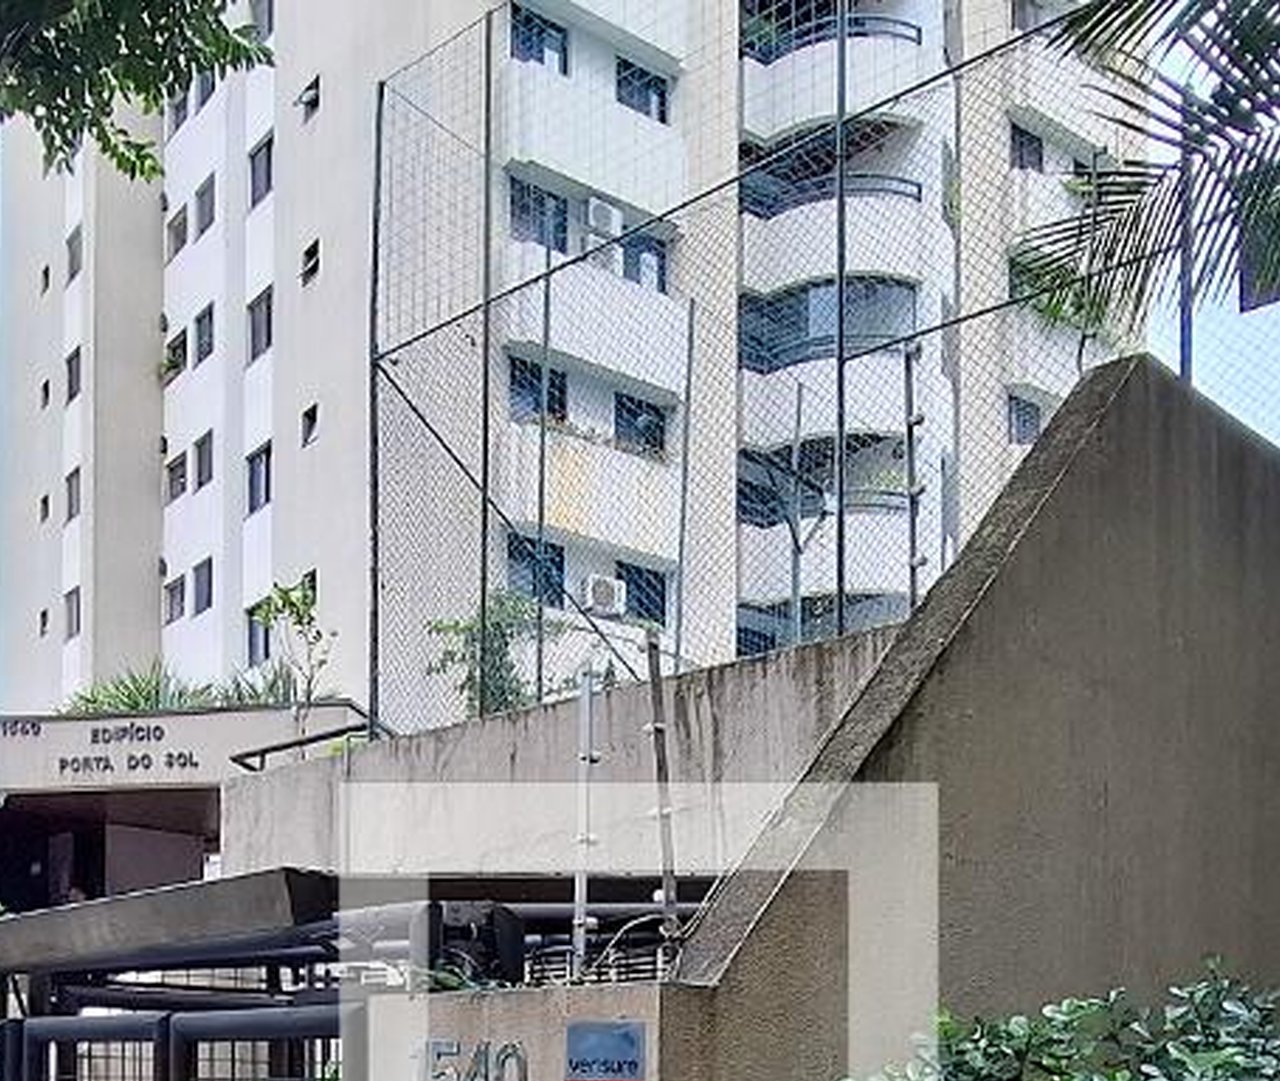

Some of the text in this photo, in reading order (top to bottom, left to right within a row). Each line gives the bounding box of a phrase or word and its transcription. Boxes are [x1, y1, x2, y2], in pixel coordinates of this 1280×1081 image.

[58, 751, 199, 774] PORTA DO SOL
